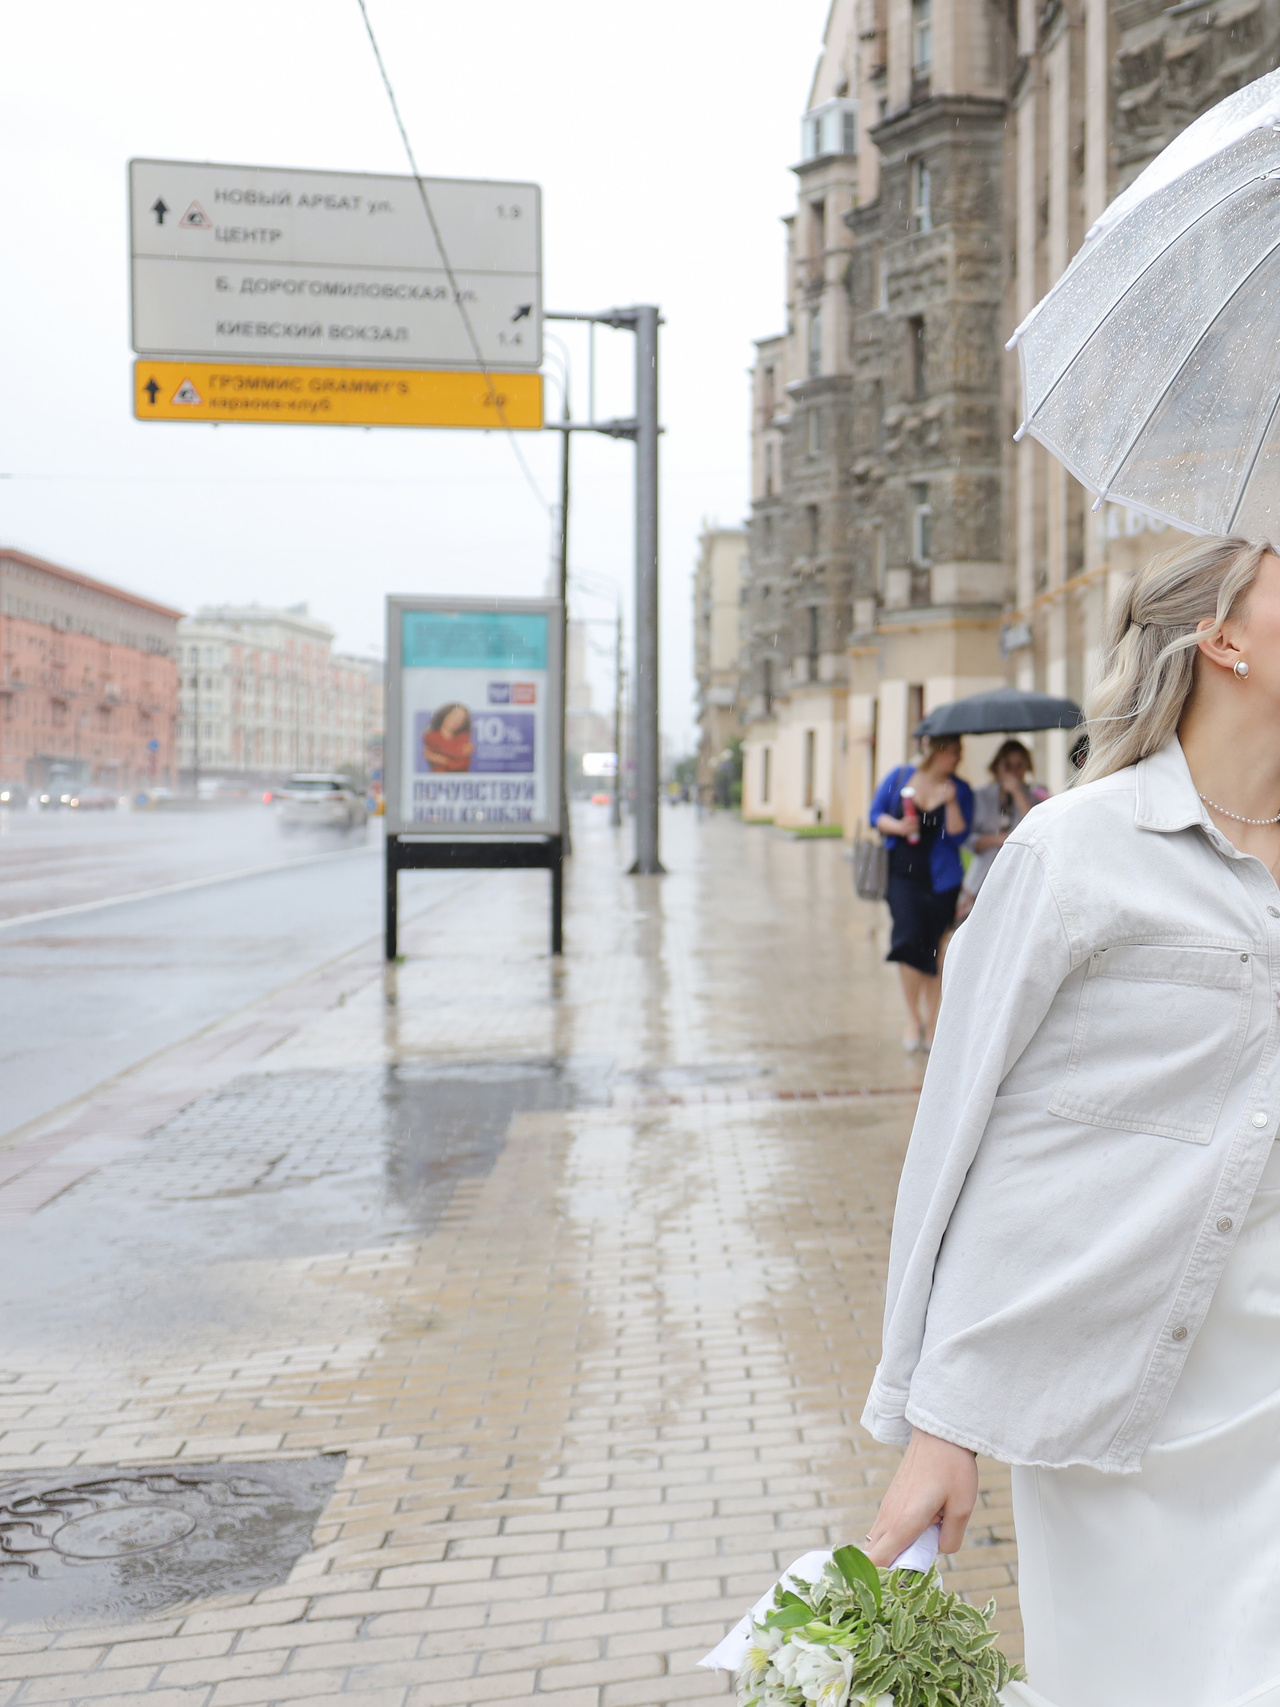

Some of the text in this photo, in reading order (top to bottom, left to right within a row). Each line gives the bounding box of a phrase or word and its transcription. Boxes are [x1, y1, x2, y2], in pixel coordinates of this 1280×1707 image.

[214, 187, 292, 208] НОВЫЙ
[297, 191, 362, 211] АРБАТ
[214, 225, 282, 244] ЦЕНТР
[239, 276, 448, 300] ДОРОГОМИЛОВСКАЯ
[215, 319, 409, 343] КИЕВСКИЙ ВОКЗАЛ
[208, 374, 303, 392] ГРЭММИС
[413, 780, 535, 802] ПОЧУВСТВУЙ
